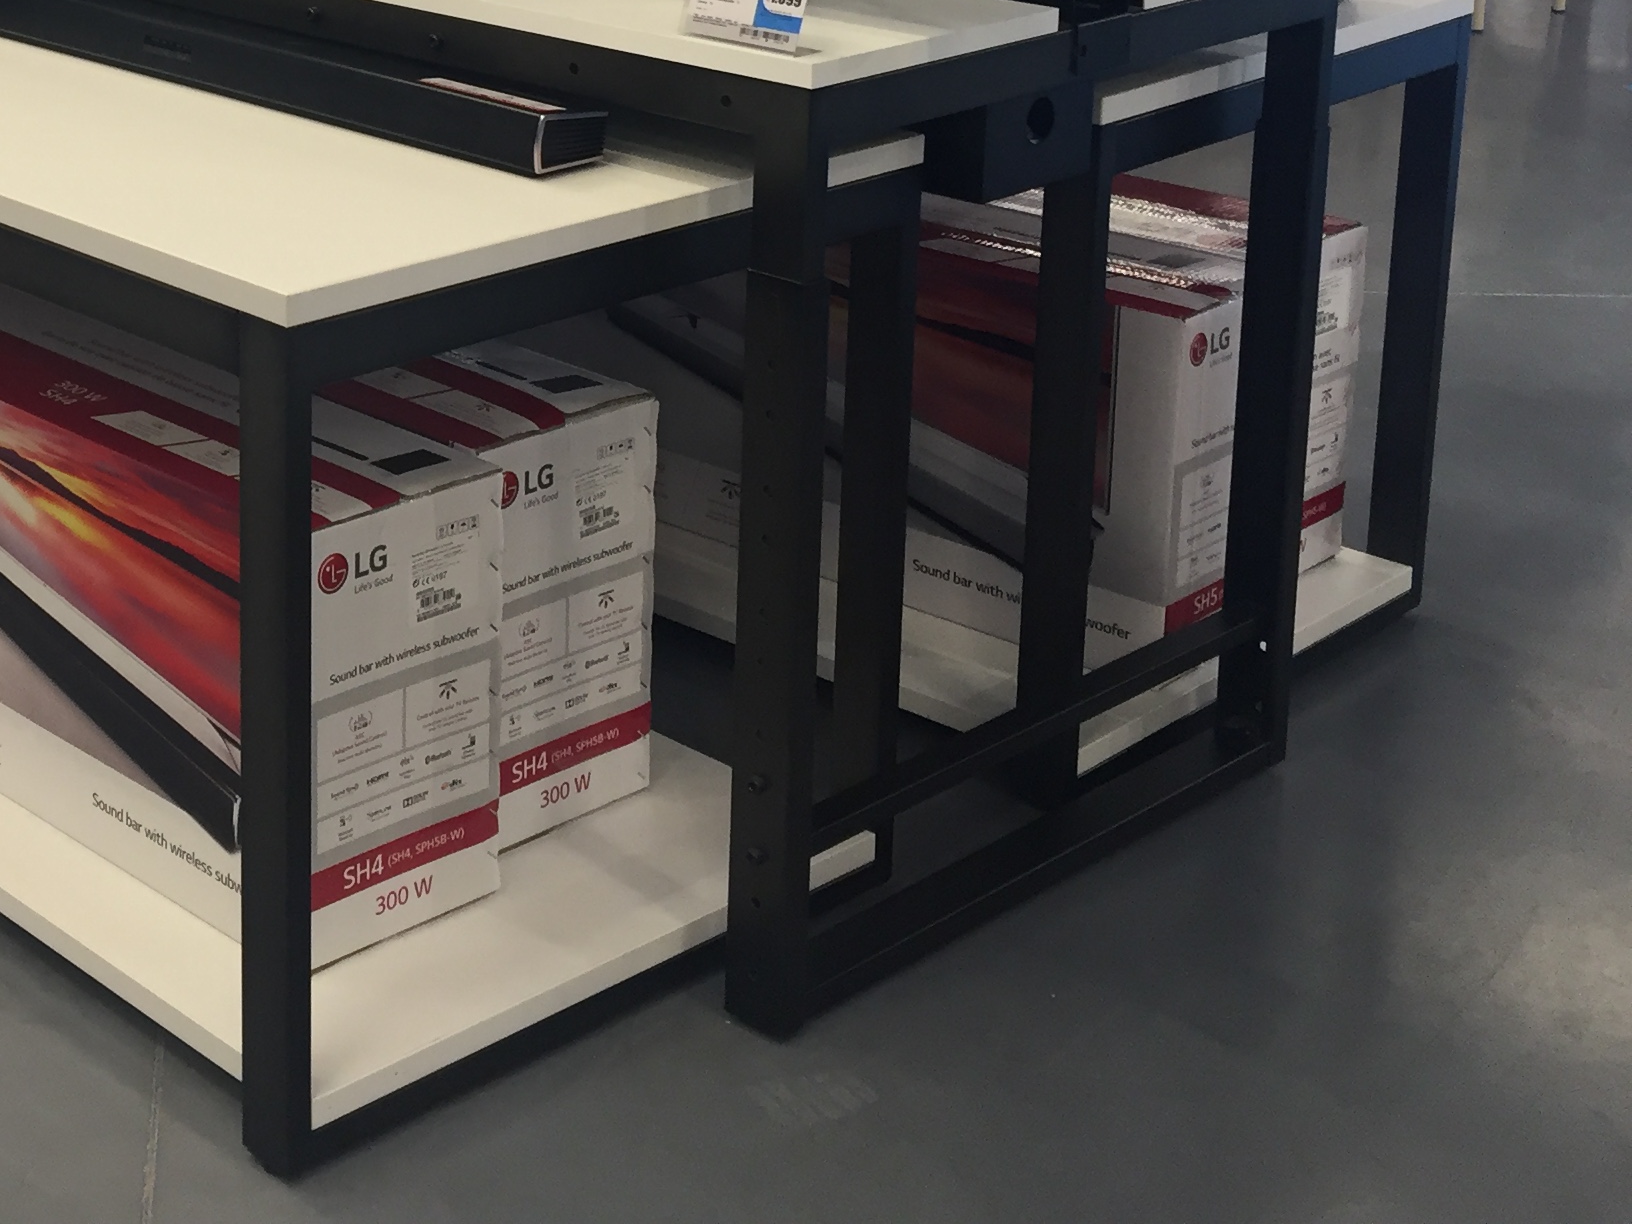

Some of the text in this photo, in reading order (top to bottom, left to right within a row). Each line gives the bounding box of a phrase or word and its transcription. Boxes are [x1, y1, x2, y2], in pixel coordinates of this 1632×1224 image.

[1210, 326, 1231, 355] LG
[524, 463, 554, 495] LG
[541, 491, 558, 504] Good
[354, 544, 388, 579] LG
[502, 540, 633, 594] Sound bar with wireless subwoofer
[912, 559, 950, 581] Sound
[953, 571, 973, 589] bar
[976, 581, 1004, 599] with
[374, 573, 394, 588] Good
[1193, 587, 1218, 615] SH5
[329, 626, 480, 686] Sound bar with wireless subwoofer
[512, 751, 548, 784] SH4
[540, 771, 591, 809] 300 W
[92, 792, 124, 823] Sound
[125, 811, 142, 833] bar
[144, 827, 168, 850] with
[170, 843, 213, 877] wireless
[343, 827, 465, 890] SH4 (SH4, SPH5B-W)
[375, 874, 434, 916] 300 W
